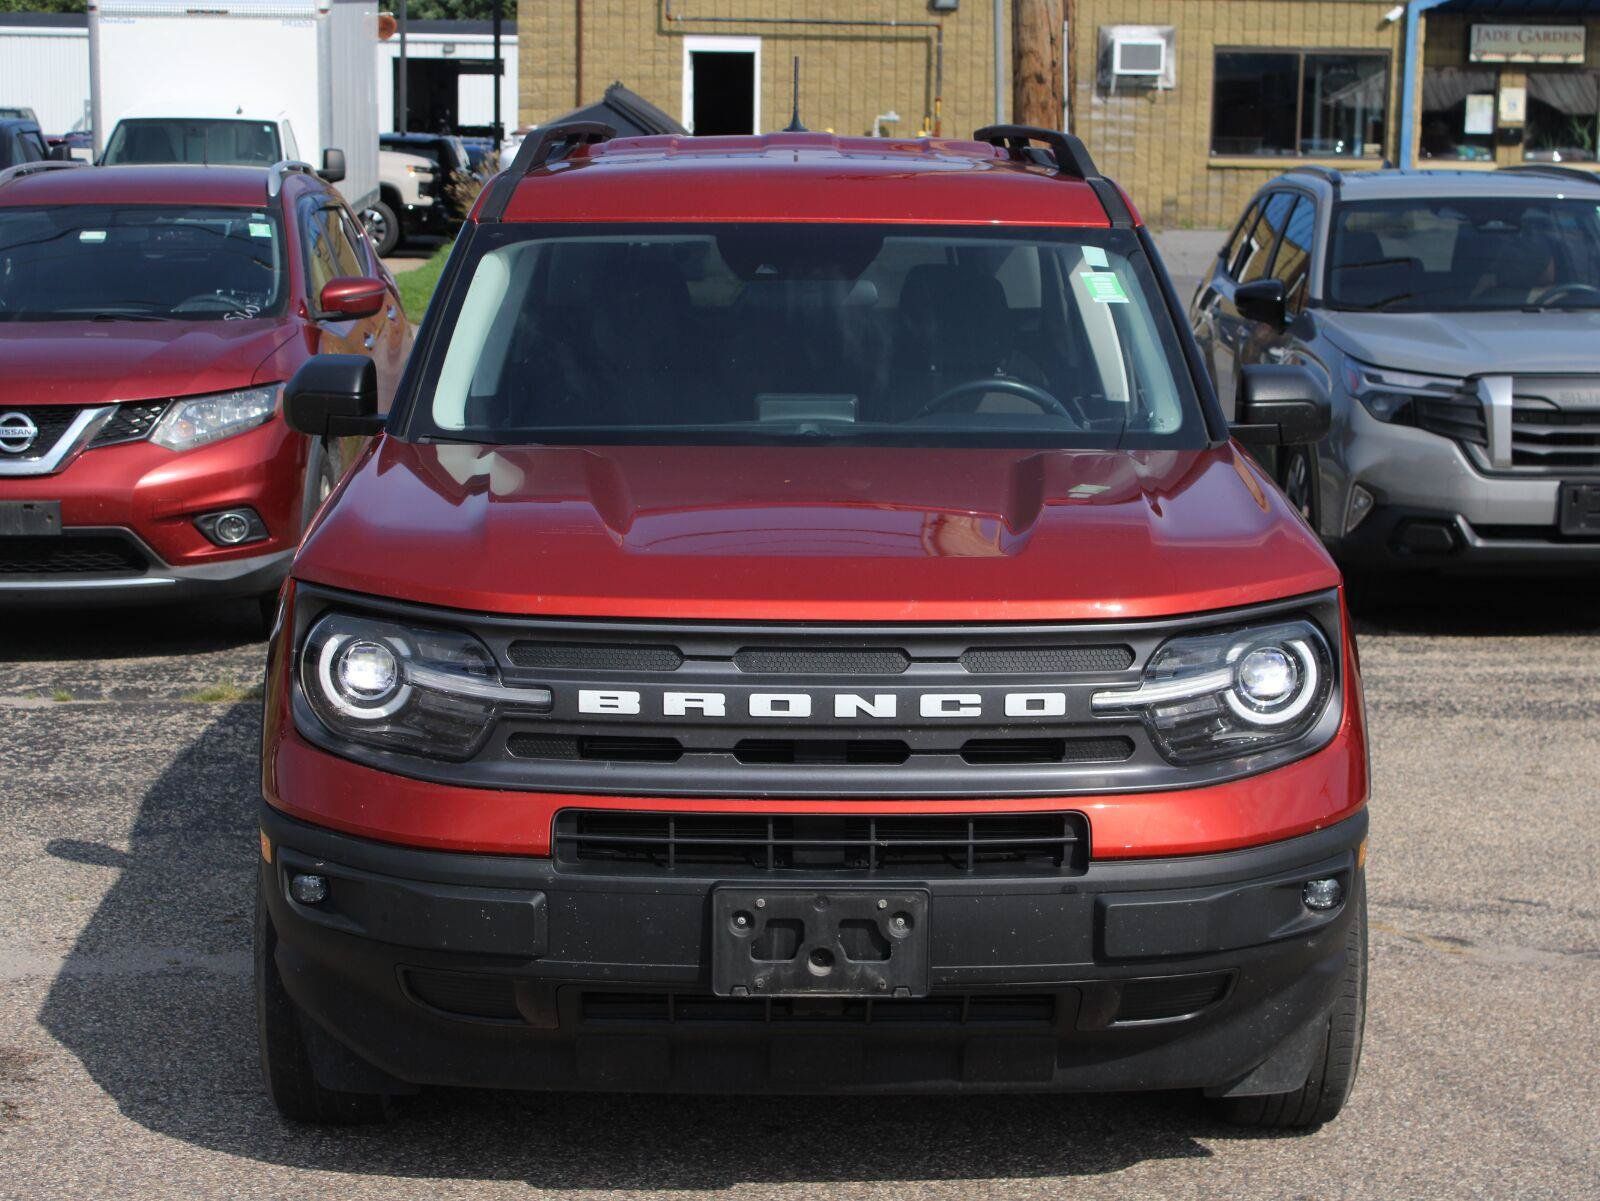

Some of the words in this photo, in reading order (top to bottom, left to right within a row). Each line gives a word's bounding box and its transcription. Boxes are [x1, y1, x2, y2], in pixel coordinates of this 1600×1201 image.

[1475, 26, 1511, 45] JADE
[1517, 27, 1583, 44] GARDEN
[578, 689, 1066, 718] BRONCO
